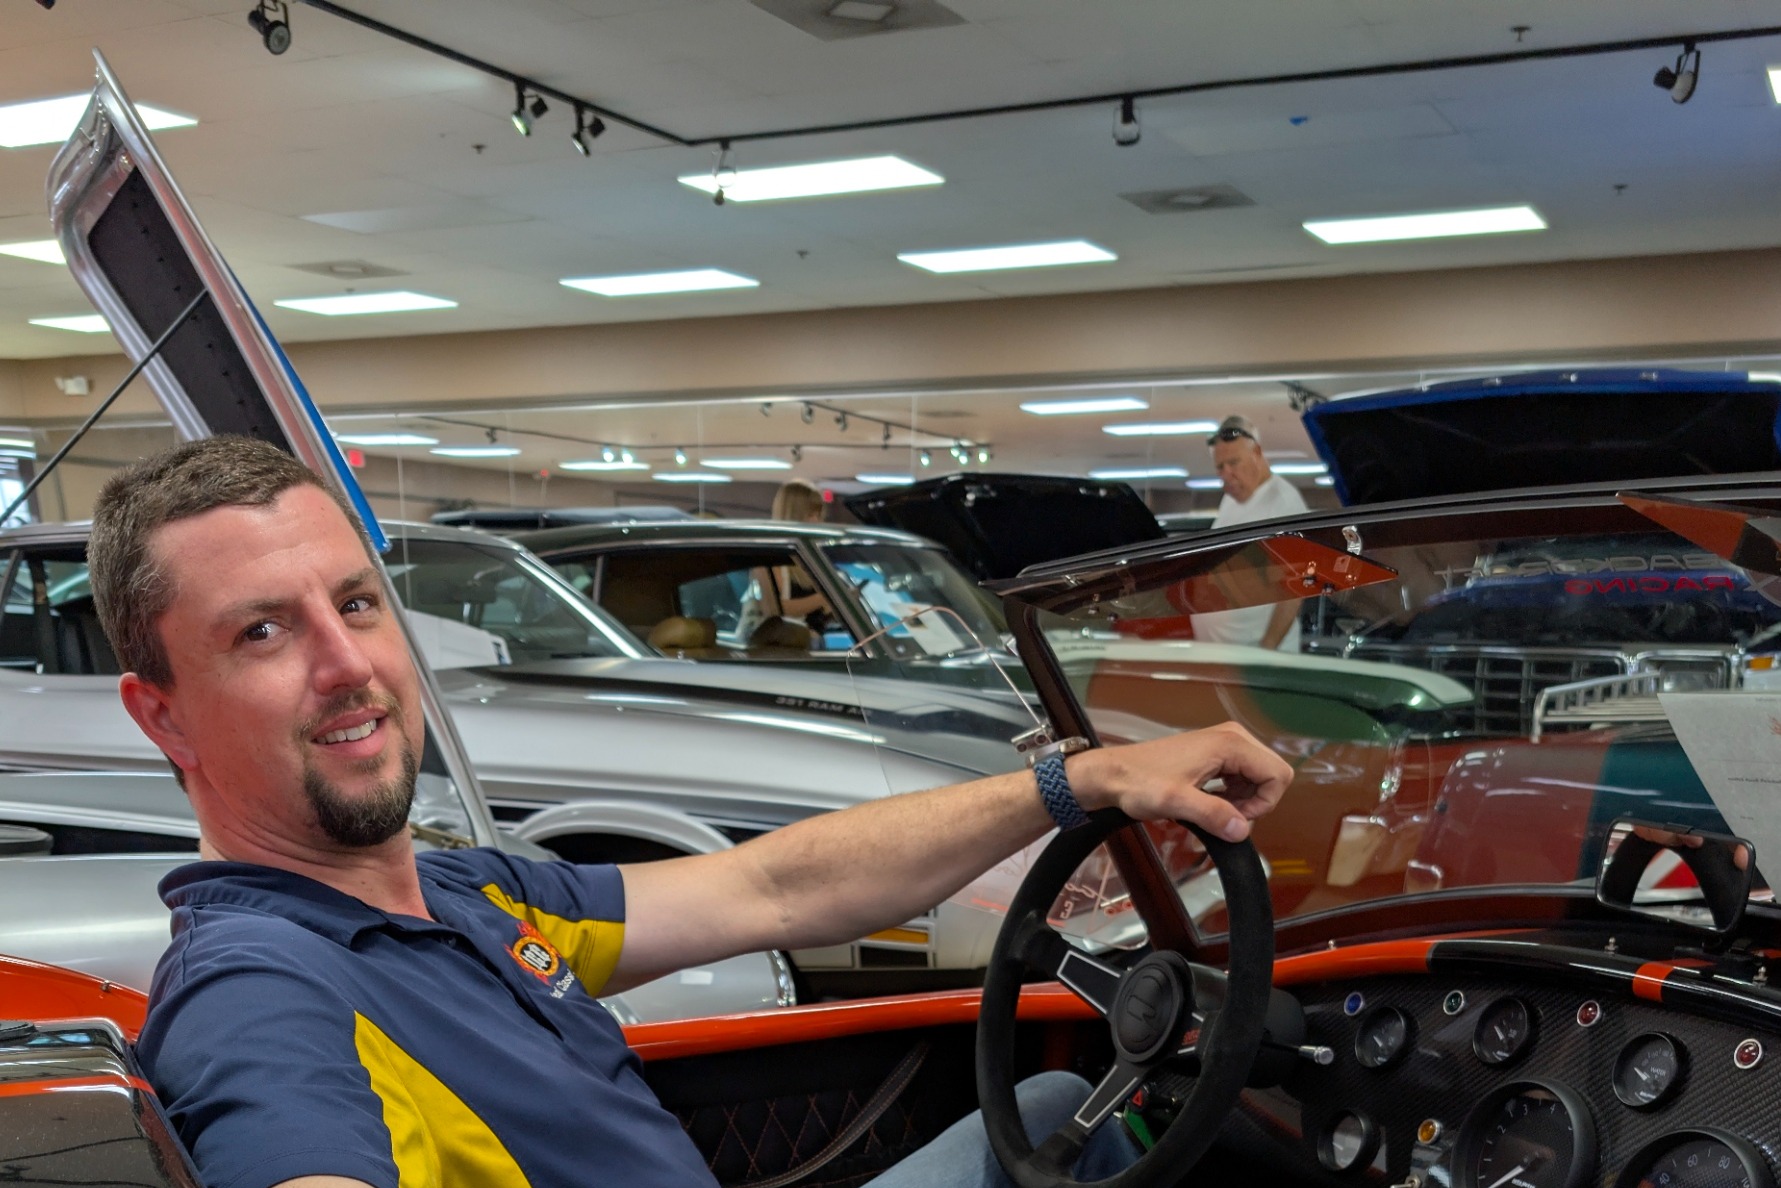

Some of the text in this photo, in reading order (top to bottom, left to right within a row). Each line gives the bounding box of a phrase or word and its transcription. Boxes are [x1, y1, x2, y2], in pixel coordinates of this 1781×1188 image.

[775, 696, 805, 707] 351
[807, 701, 845, 713] RAM
[1687, 1153, 1699, 1167] 60
[1718, 1155, 1732, 1170] 80
[1659, 1172, 1671, 1185] 40
